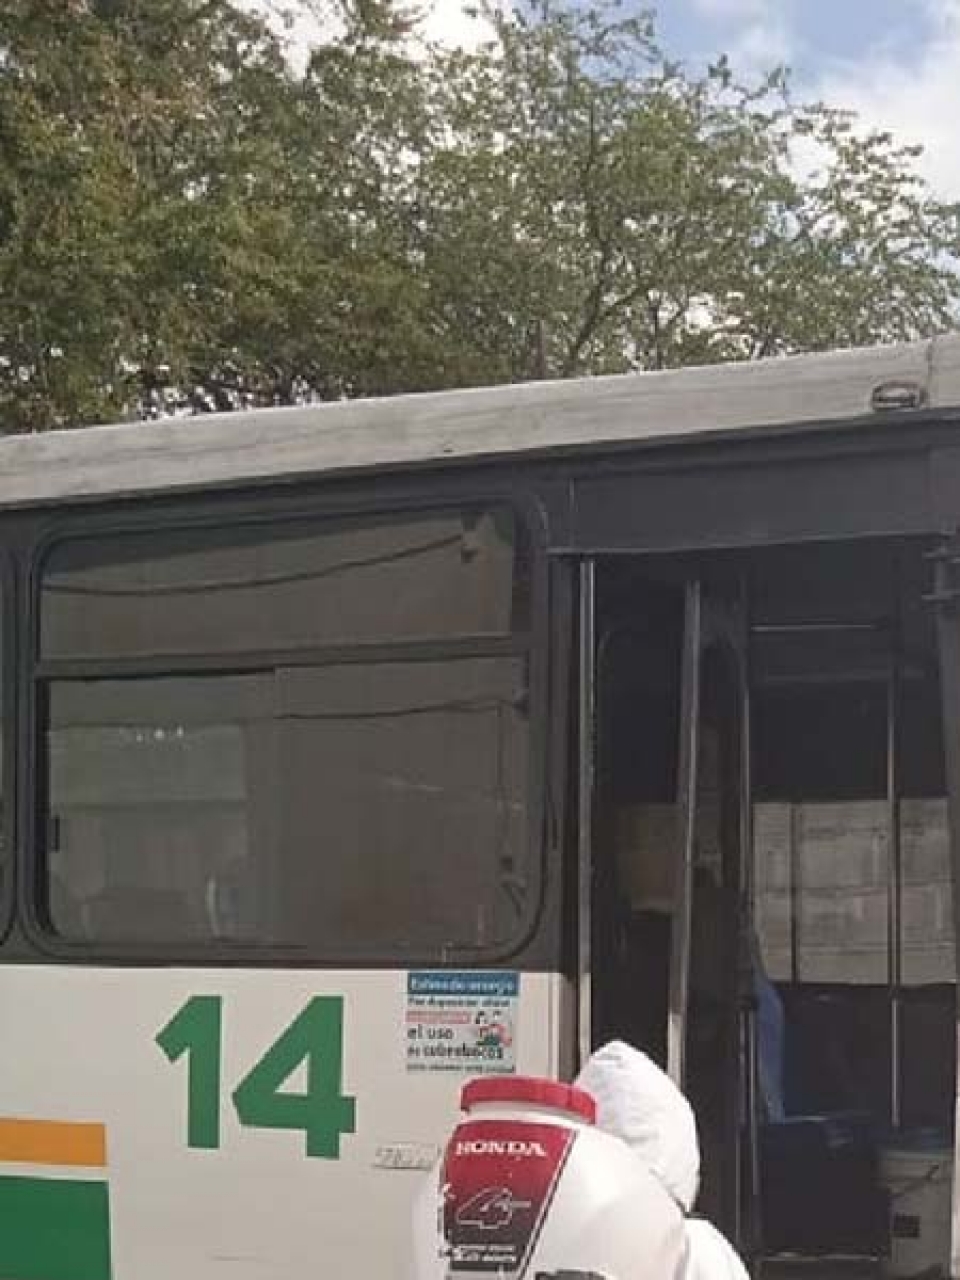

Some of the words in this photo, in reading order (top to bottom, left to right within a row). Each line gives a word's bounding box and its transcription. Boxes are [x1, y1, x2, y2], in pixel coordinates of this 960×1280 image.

[407, 1024, 423, 1040] el
[427, 1028, 454, 1040] uso
[154, 995, 356, 1159] 14
[455, 1140, 546, 1157] HONDA
